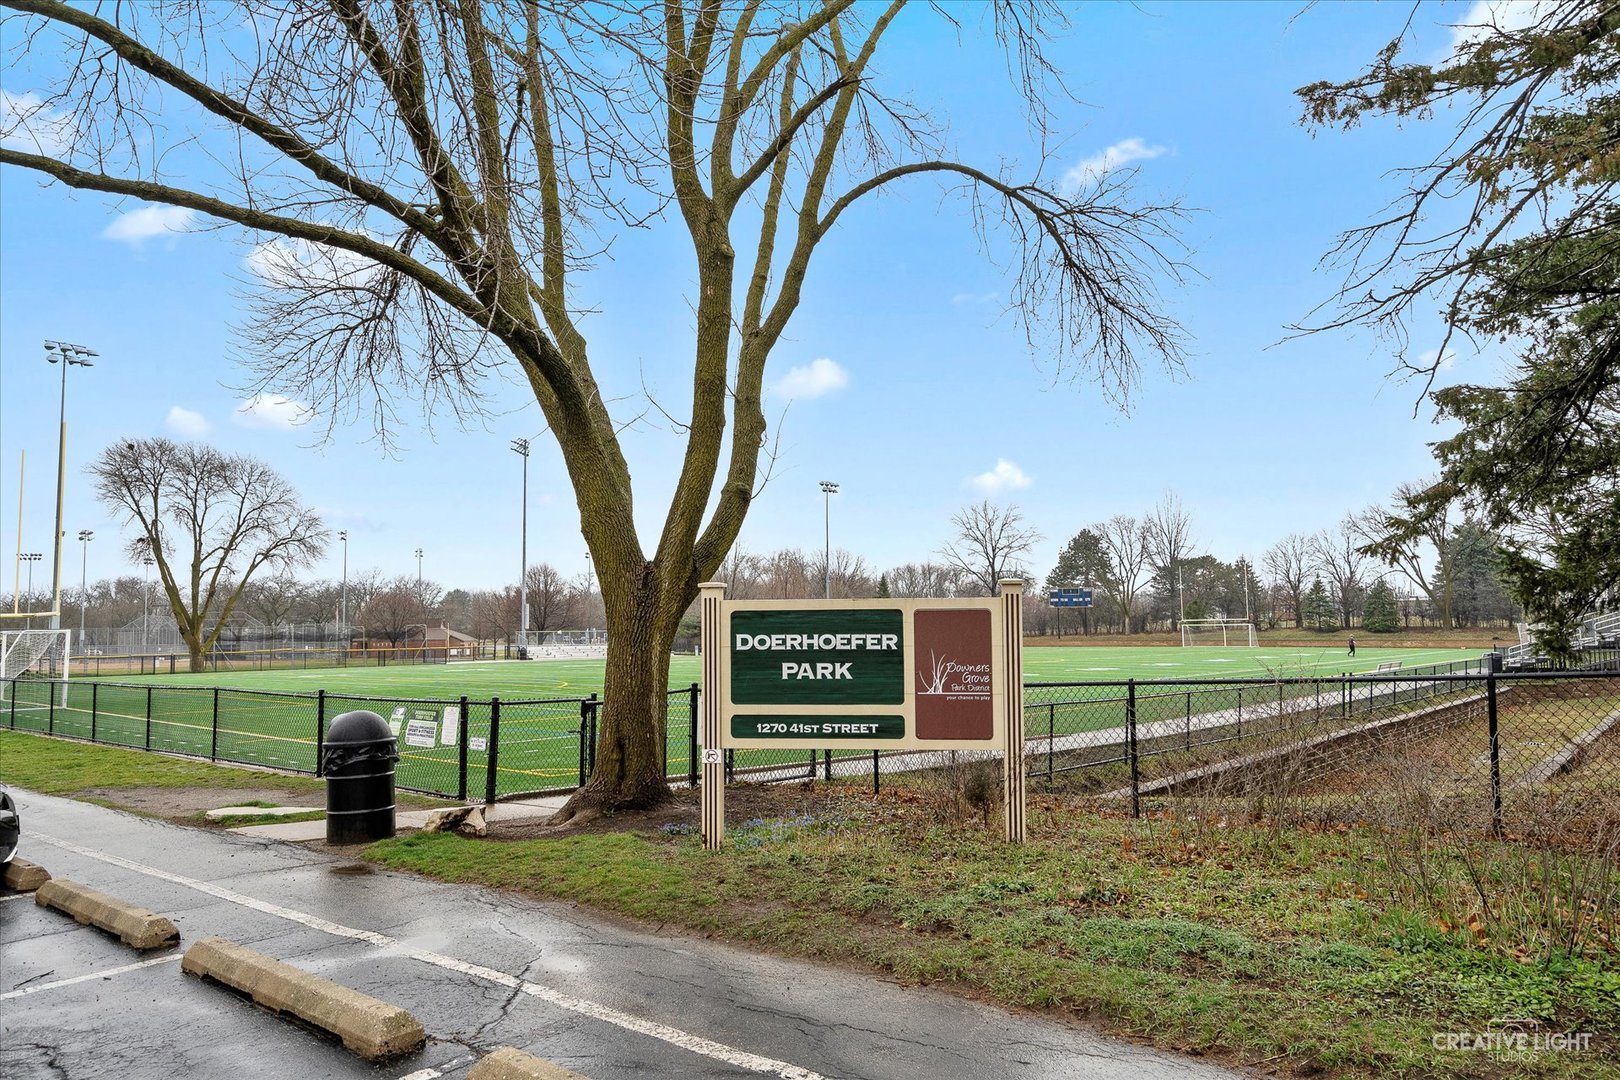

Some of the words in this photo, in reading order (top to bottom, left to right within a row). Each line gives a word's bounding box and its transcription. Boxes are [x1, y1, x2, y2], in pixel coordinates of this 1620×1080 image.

[736, 633, 898, 651] DOERHOEFER
[781, 662, 853, 680] PARK
[946, 662, 990, 672] Downers
[961, 672, 990, 683] Grove
[951, 683, 966, 691] Park
[757, 723, 788, 734] 1270
[789, 723, 820, 734] 41ST
[822, 723, 879, 734] STREET
